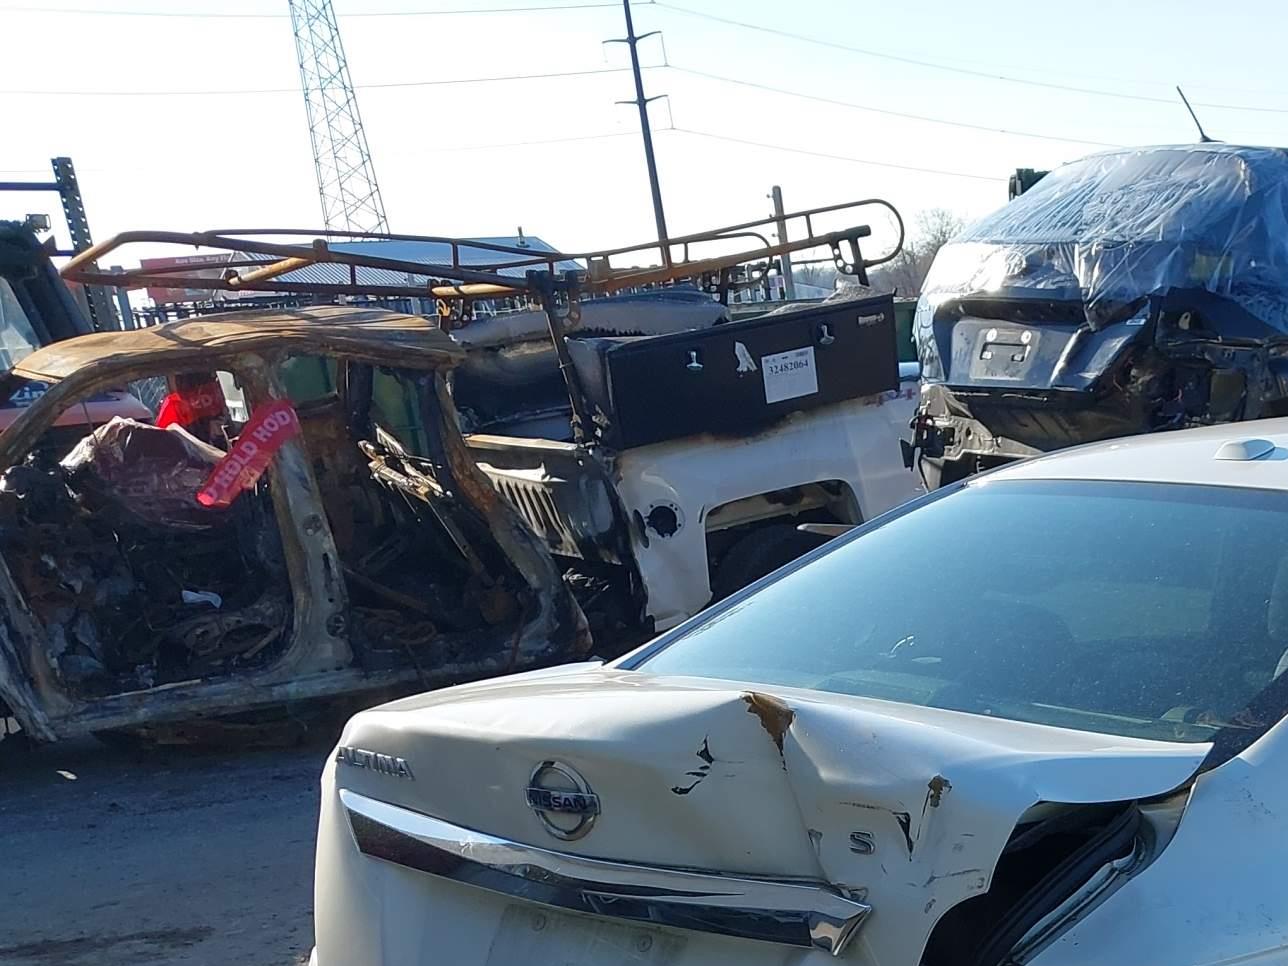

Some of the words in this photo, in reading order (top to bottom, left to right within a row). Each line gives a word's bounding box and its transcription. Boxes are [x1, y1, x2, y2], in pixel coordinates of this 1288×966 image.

[336, 746, 416, 781] ALTIMA
[528, 791, 587, 811] NISSAN
[849, 830, 876, 856] S
